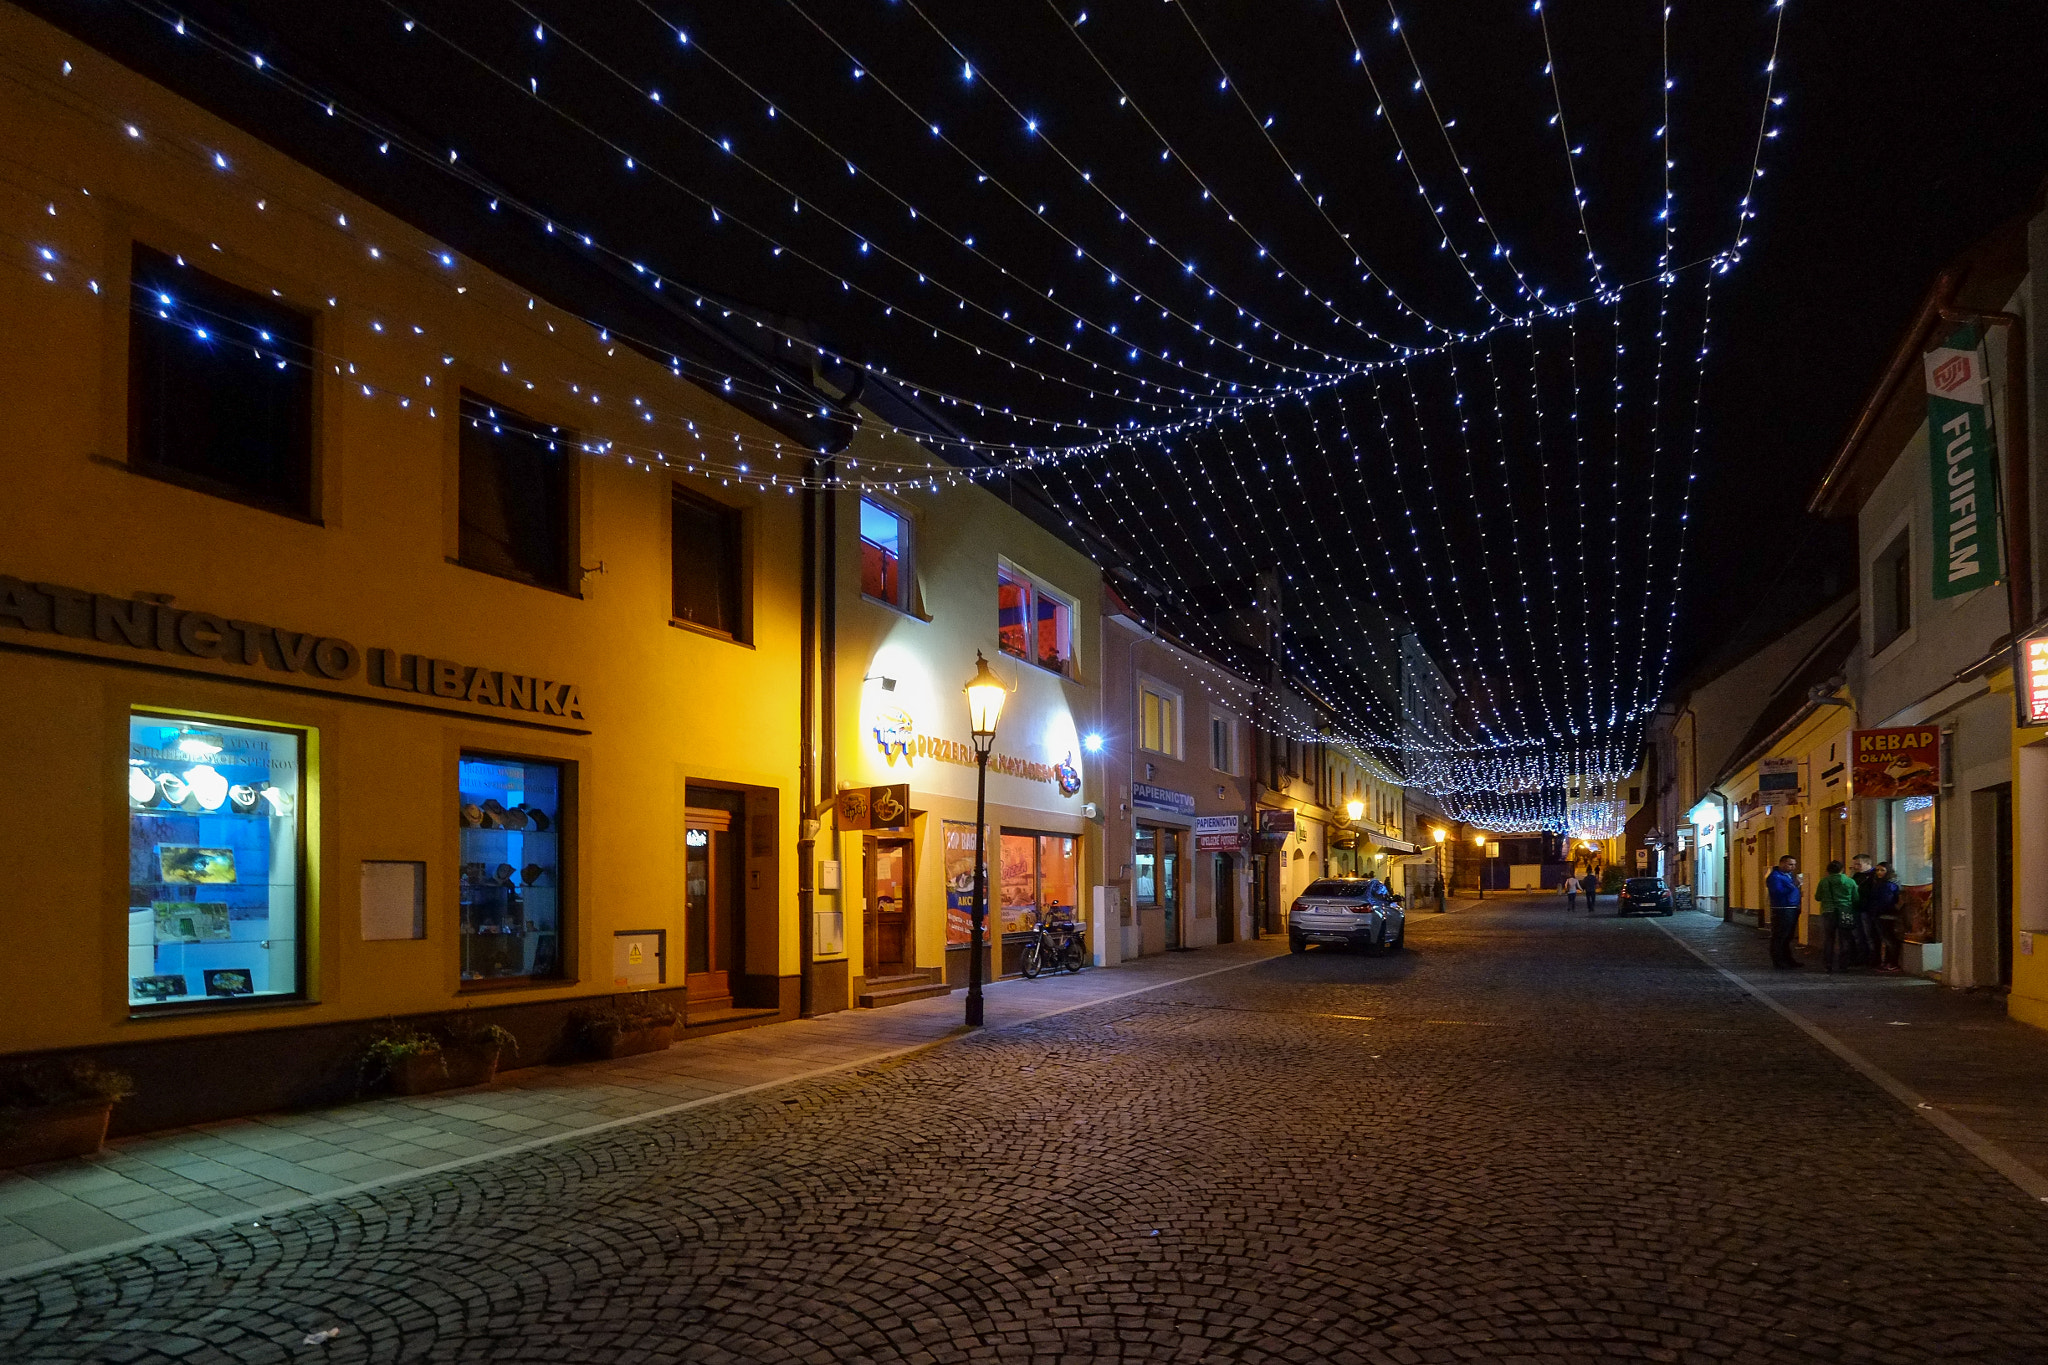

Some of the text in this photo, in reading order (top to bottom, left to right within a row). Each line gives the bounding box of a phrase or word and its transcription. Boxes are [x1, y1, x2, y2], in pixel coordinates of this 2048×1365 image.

[1942, 411, 1980, 583] FUJIFILM
[367, 647, 586, 720] LIBANKA
[1860, 732, 1934, 752] KEBAP
[1860, 753, 1892, 763] O&M
[1134, 783, 1195, 806] PAPIERNICTVO
[1196, 817, 1237, 829] PAPIERNICTVO
